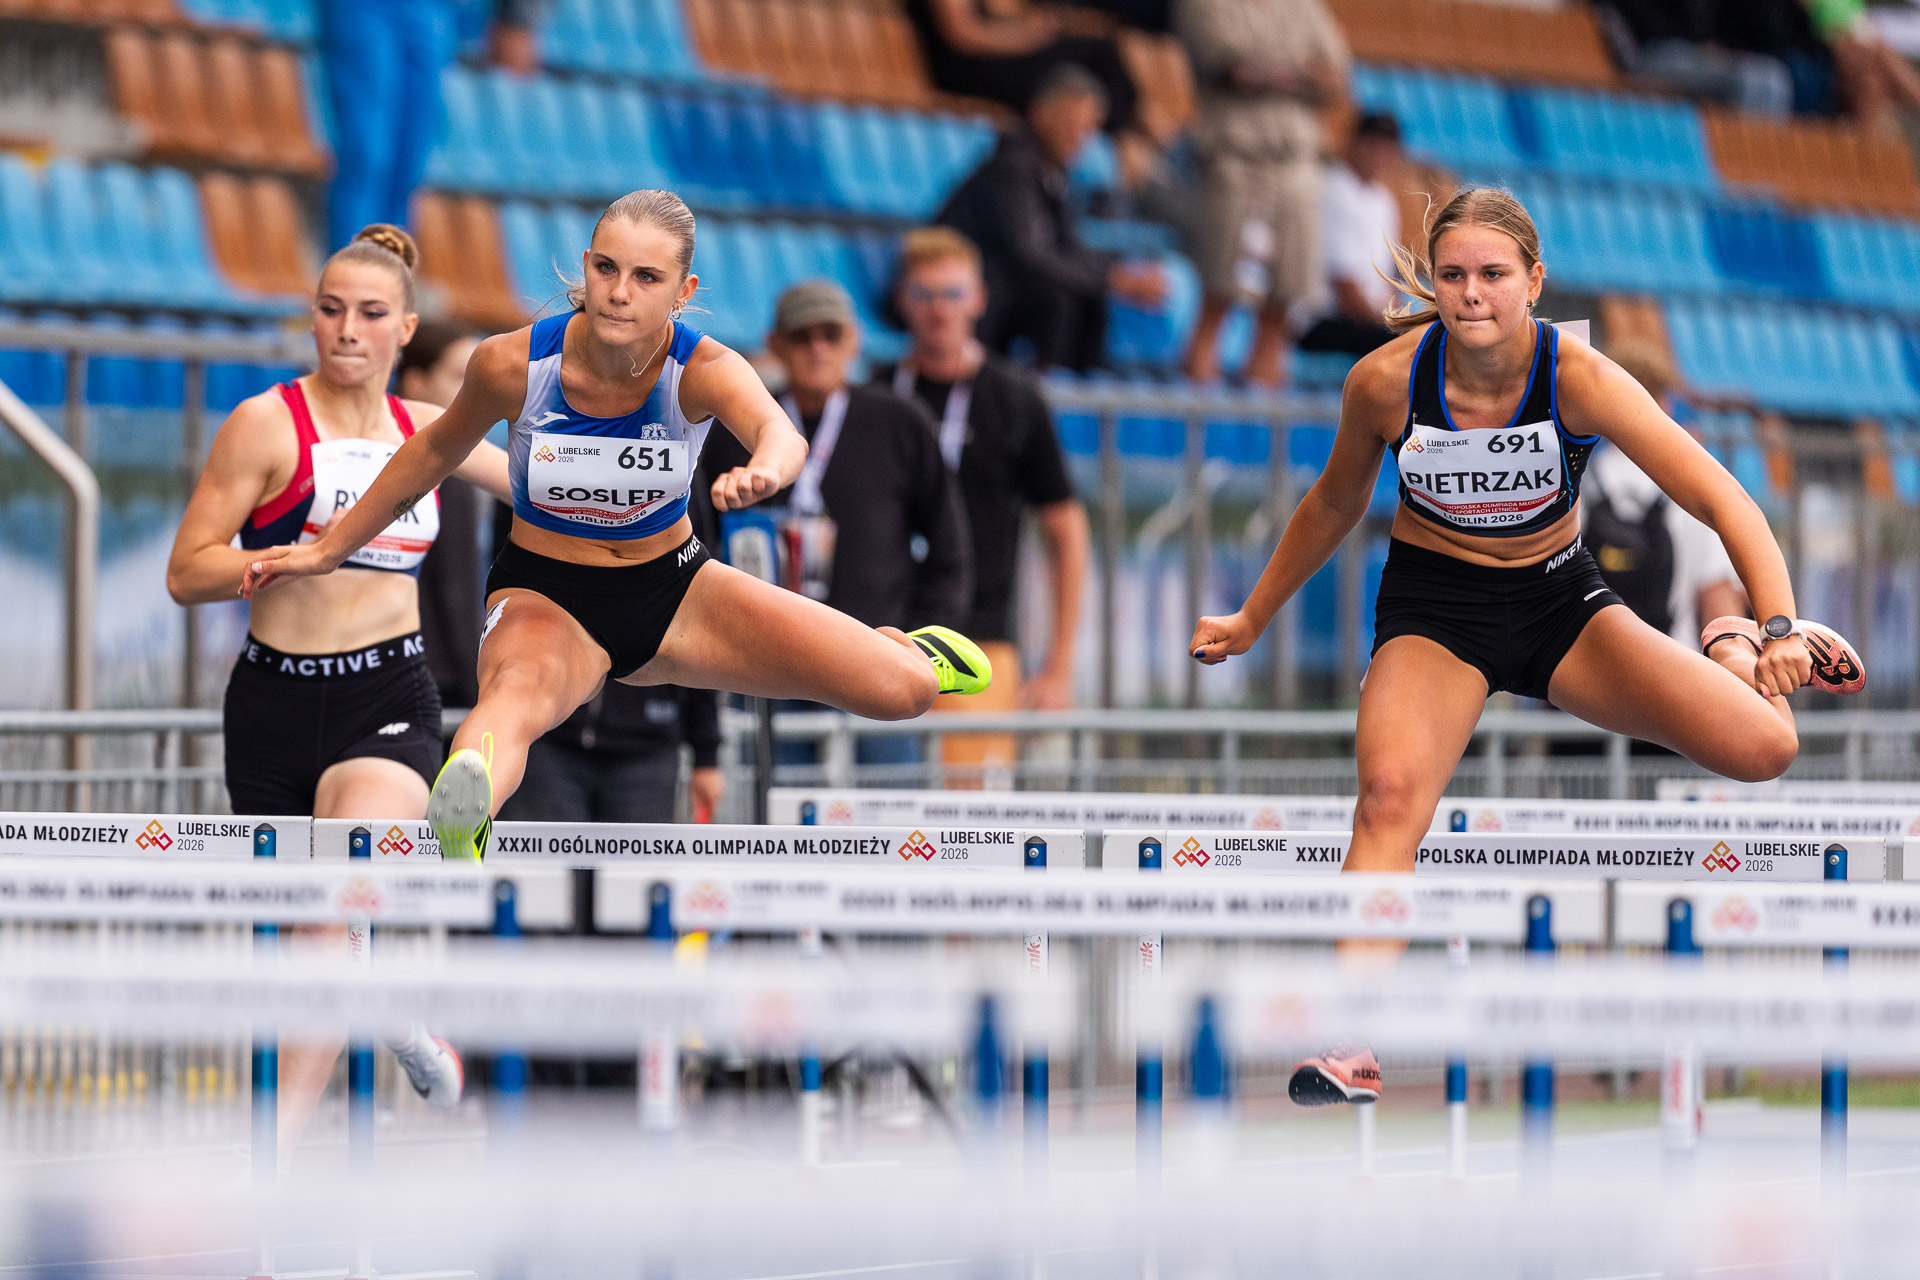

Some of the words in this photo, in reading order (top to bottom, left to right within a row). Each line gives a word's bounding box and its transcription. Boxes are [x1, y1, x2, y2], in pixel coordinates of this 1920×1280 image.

[1426, 438, 1470, 448] LUBELSKIE
[1487, 431, 1545, 454] 691
[558, 446, 601, 456] LUBELSKIE
[617, 445, 674, 472] 651
[558, 455, 575, 463] 2026
[1405, 467, 1556, 494] PIETRZAK
[569, 514, 614, 526] LUBLIN
[617, 509, 647, 526] 2026
[1443, 512, 1488, 525] LUBLIN
[1490, 513, 1524, 525] 2026
[678, 540, 701, 568] NIKE
[1545, 542, 1577, 574] NIKE
[279, 648, 382, 677] ACTIVE
[33, 824, 129, 843] MŁODZIEŻY
[178, 822, 251, 838] LUBELSKIE
[177, 838, 205, 852] 2026
[497, 836, 543, 853] XXXII
[549, 834, 687, 855] OGÓLNOPOLSKA
[692, 838, 788, 855] OLIMPIADA
[794, 836, 891, 855] MŁODZIEŻY
[940, 831, 1015, 845] LUBELSKIE
[1214, 838, 1288, 852] LUBELSKIE
[940, 847, 969, 861] 2026
[1295, 846, 1342, 863] XXXII
[1493, 848, 1591, 866] OLIMPIADA
[1597, 847, 1695, 866] MŁODZIEŻY
[1745, 842, 1820, 857] LUBELSKIE
[1214, 854, 1243, 867] 2026
[1745, 859, 1774, 872] 2026
